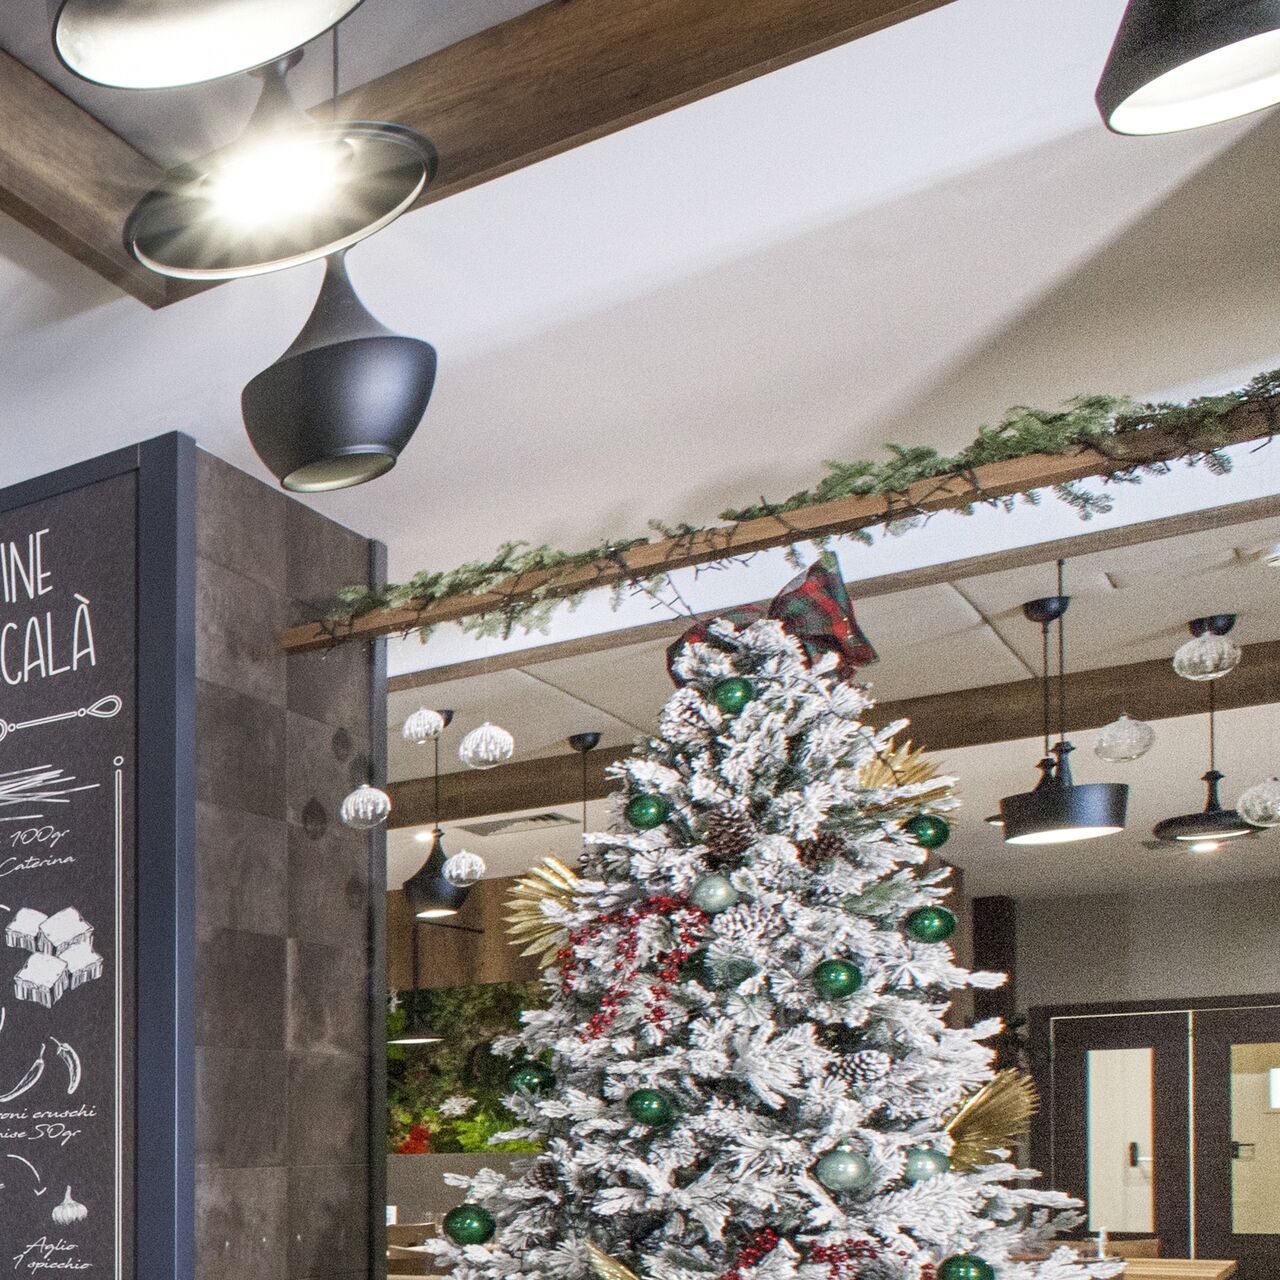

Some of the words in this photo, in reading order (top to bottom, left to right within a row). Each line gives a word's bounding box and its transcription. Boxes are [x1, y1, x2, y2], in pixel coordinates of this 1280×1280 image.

[10, 825, 72, 850] 100gr
[32, 1104, 98, 1119] cruschi
[23, 1236, 79, 1260] Aglio
[27, 1256, 93, 1275] spicchio
